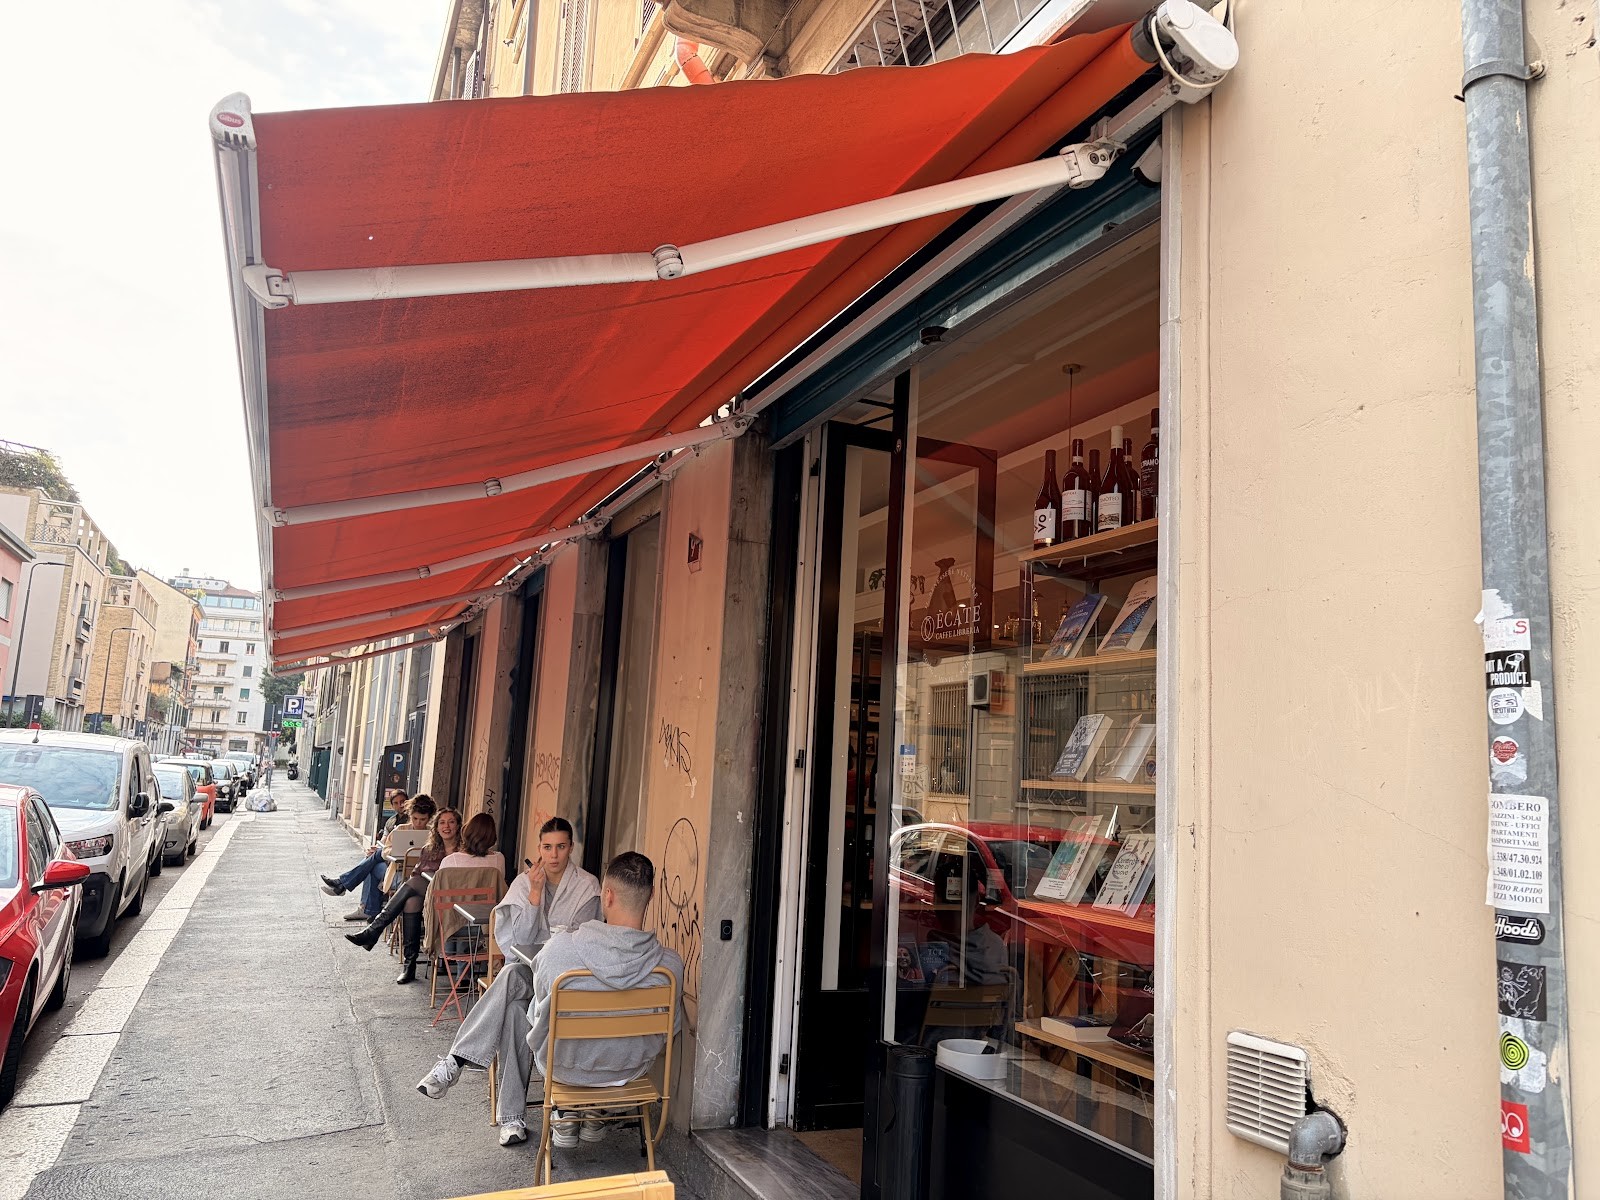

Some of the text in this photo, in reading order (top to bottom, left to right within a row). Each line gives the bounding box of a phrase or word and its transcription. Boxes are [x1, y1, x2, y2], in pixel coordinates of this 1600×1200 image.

[936, 604, 981, 629] ÈCATE
[1497, 659, 1504, 672] A
[288, 698, 300, 713] P
[393, 753, 404, 768] P
[1491, 800, 1541, 812] OMBERO
[1510, 894, 1543, 904] MODICI
[1495, 917, 1539, 937] Hoods
